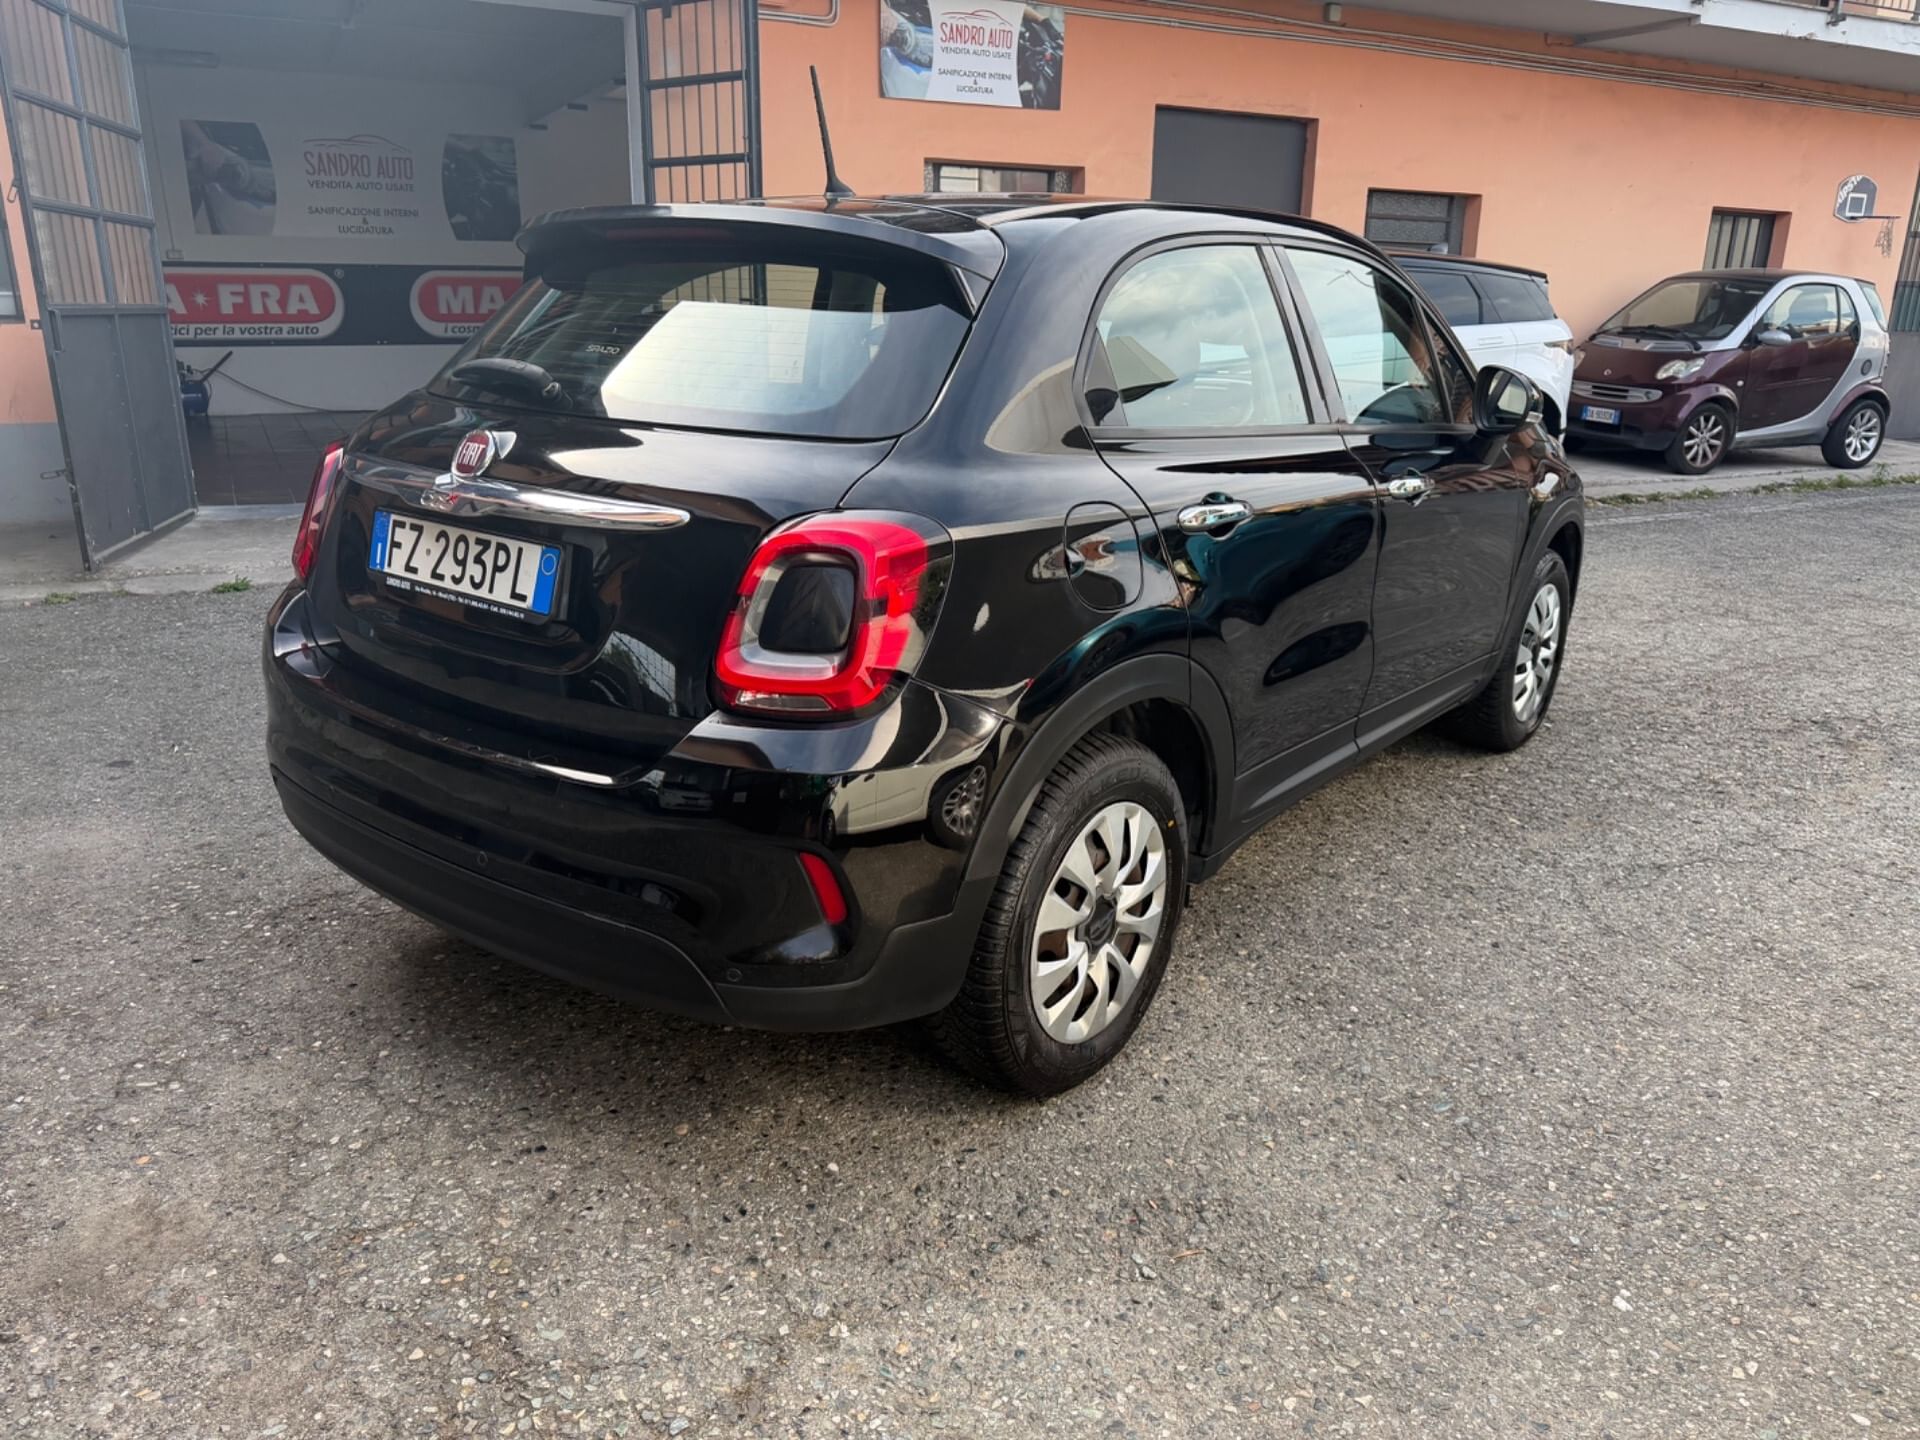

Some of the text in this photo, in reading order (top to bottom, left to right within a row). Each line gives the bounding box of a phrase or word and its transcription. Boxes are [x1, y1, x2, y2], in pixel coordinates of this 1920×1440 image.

[940, 22, 1013, 49] SANDRO AUTO
[941, 46, 1012, 60] VENDITA AUTO USATE
[938, 68, 987, 79] SANIFICAZIONE
[956, 85, 994, 94] LUCIDATURA
[303, 150, 415, 181] SANDRO AUTO
[307, 179, 415, 192] VENDITA AUTO USATE
[307, 205, 382, 217] SANIFICAZIONE
[338, 225, 395, 236] LUCIDATURA
[193, 325, 219, 339] per
[222, 324, 236, 336] la
[242, 326, 285, 336] vostra
[287, 326, 320, 336] auto
[458, 442, 487, 467] FIAT
